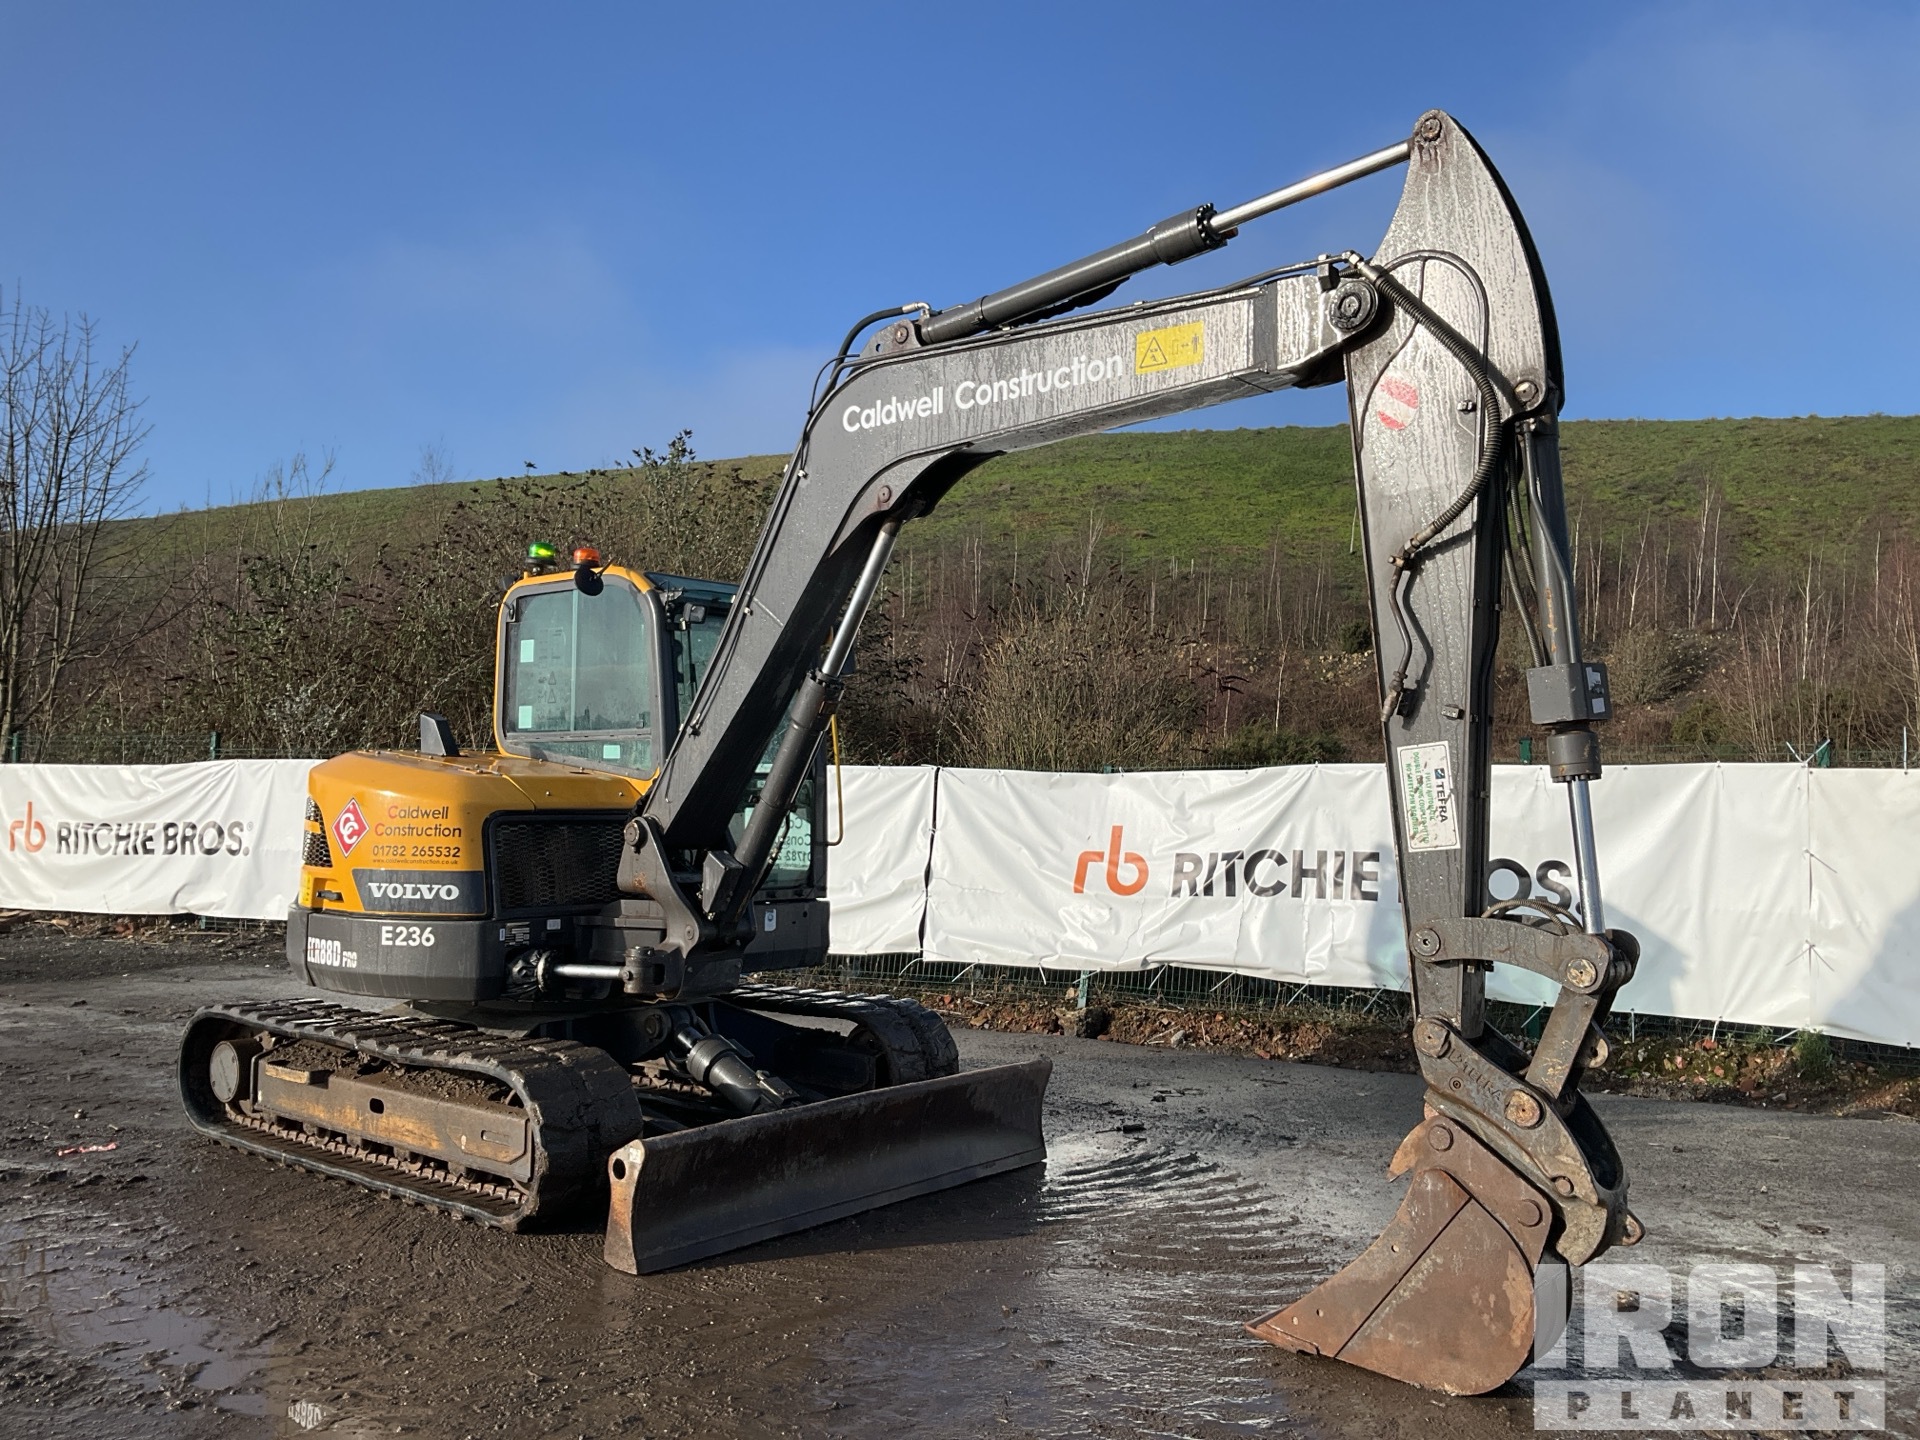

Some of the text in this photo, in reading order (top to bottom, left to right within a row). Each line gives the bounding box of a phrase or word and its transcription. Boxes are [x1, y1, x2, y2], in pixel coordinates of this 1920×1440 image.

[842, 354, 1123, 433] Caldwell Construction
[1425, 772, 1433, 789] FULLY
[387, 805, 449, 820] Caldwell
[1436, 782, 1448, 823] TEFRA
[56, 820, 156, 856] RITCHIE
[375, 822, 462, 838] Construction
[372, 845, 461, 858] 01782 265532
[1170, 850, 1380, 902] RITCHIE
[368, 882, 460, 901] VOLVO
[381, 925, 435, 947] E236
[307, 936, 358, 969] ECR88D PRO
